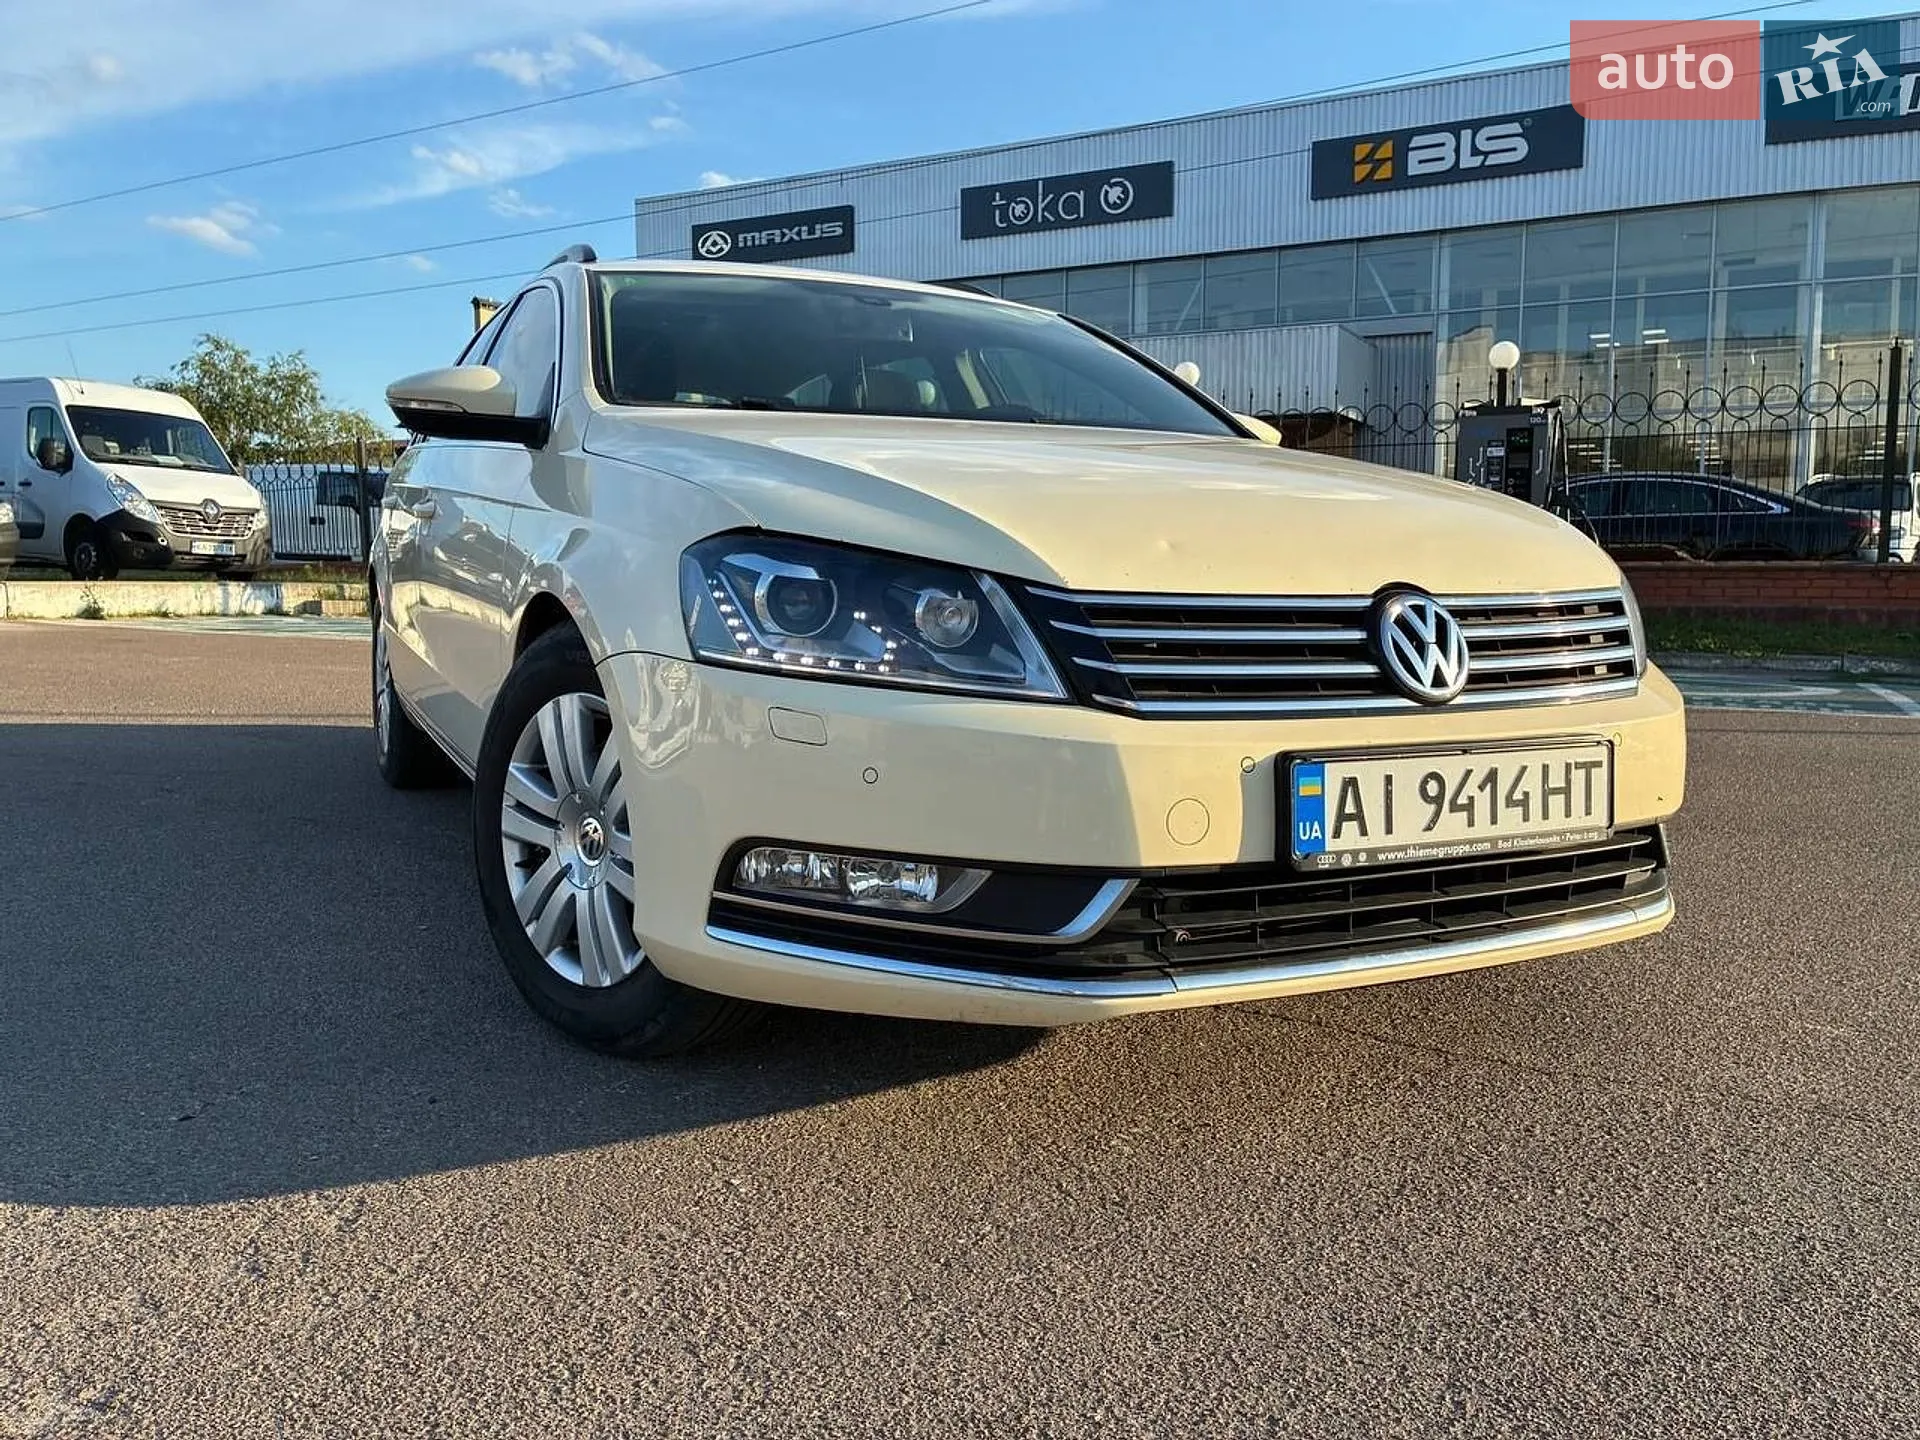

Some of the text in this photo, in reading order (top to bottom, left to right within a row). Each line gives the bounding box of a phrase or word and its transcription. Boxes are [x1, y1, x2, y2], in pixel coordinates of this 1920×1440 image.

[1407, 122, 1529, 176] BLS
[992, 180, 1085, 228] toka
[737, 222, 844, 248] MAXUS
[1298, 820, 1323, 841] UA
[1377, 842, 1491, 861] www.thiemegruppe.com
